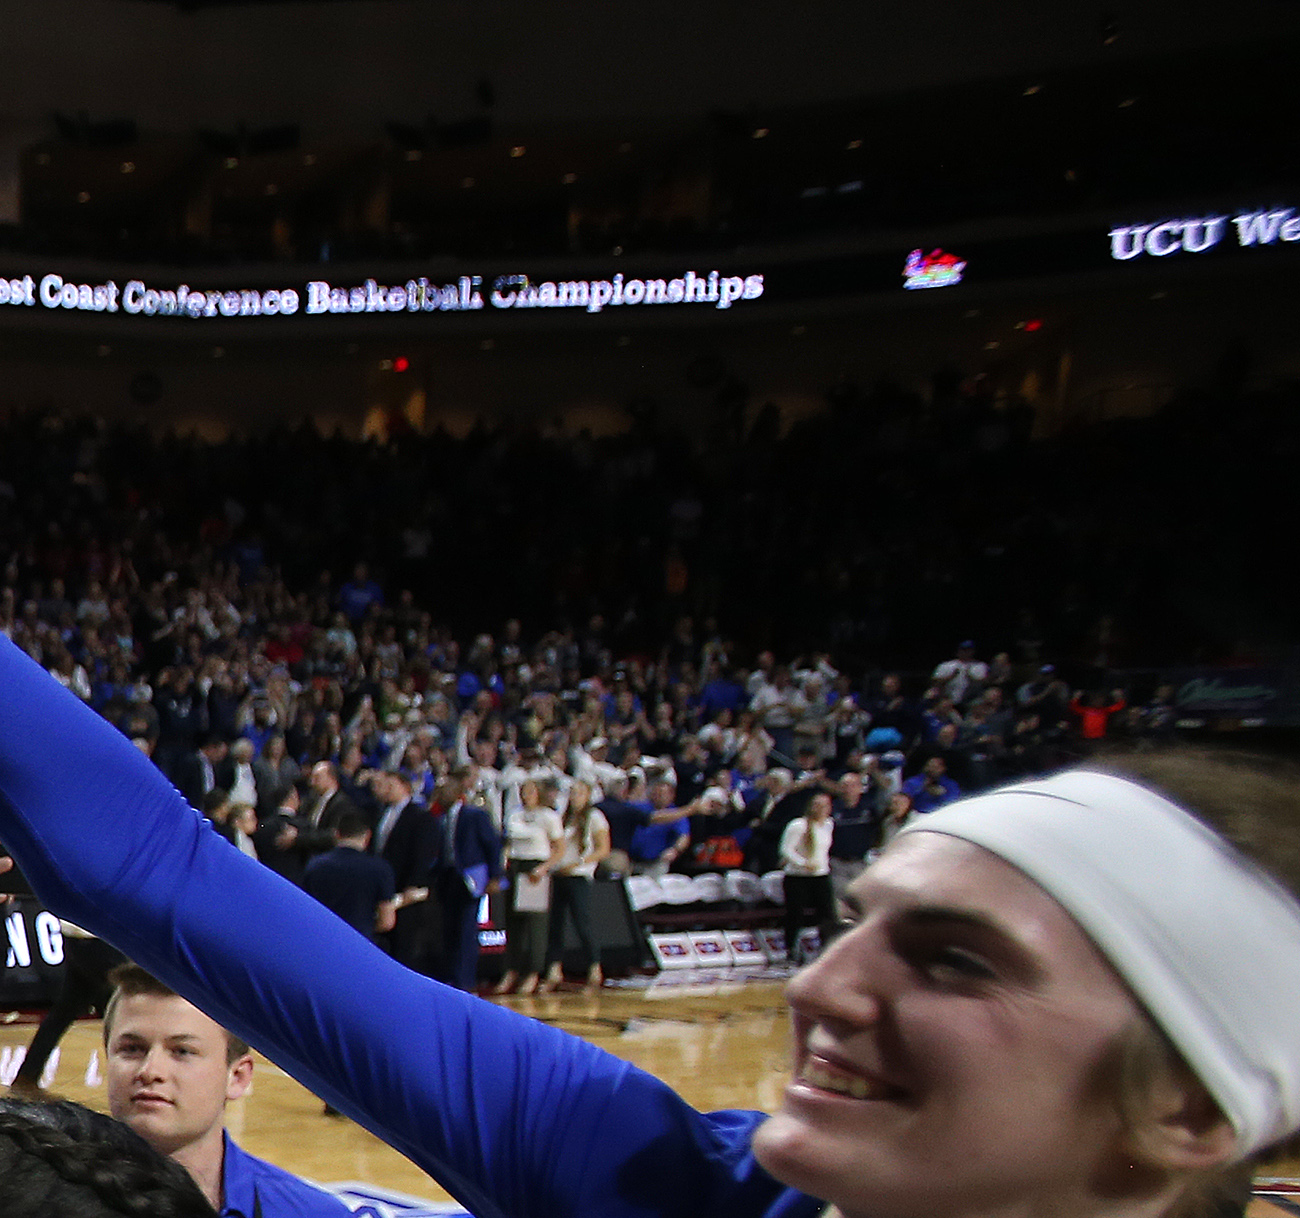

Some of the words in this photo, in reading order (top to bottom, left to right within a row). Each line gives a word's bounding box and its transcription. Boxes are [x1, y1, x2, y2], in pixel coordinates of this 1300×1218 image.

[1107, 215, 1229, 260] UCU
[39, 273, 119, 312] Coast
[122, 279, 300, 319] Conference
[305, 275, 484, 316] Basketball
[490, 270, 765, 313] Championships
